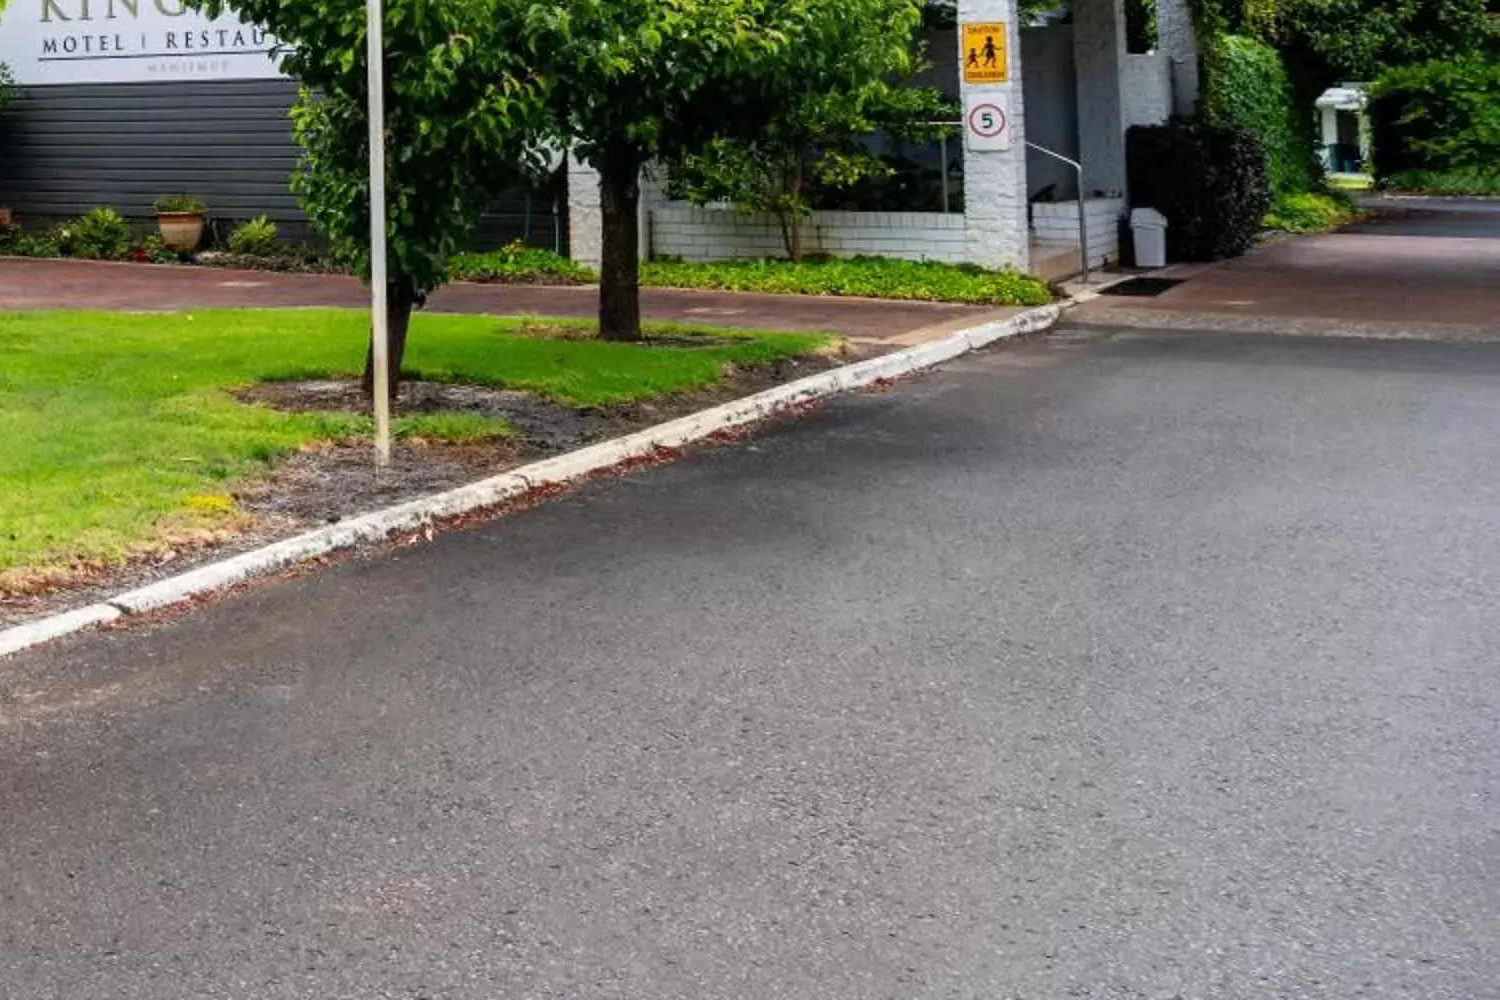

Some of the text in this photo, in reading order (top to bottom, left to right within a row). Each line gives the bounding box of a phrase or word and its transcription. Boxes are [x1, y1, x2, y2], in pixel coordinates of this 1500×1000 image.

[43, 28, 268, 54] MOTEL RESTAU
[981, 112, 993, 129] 5
